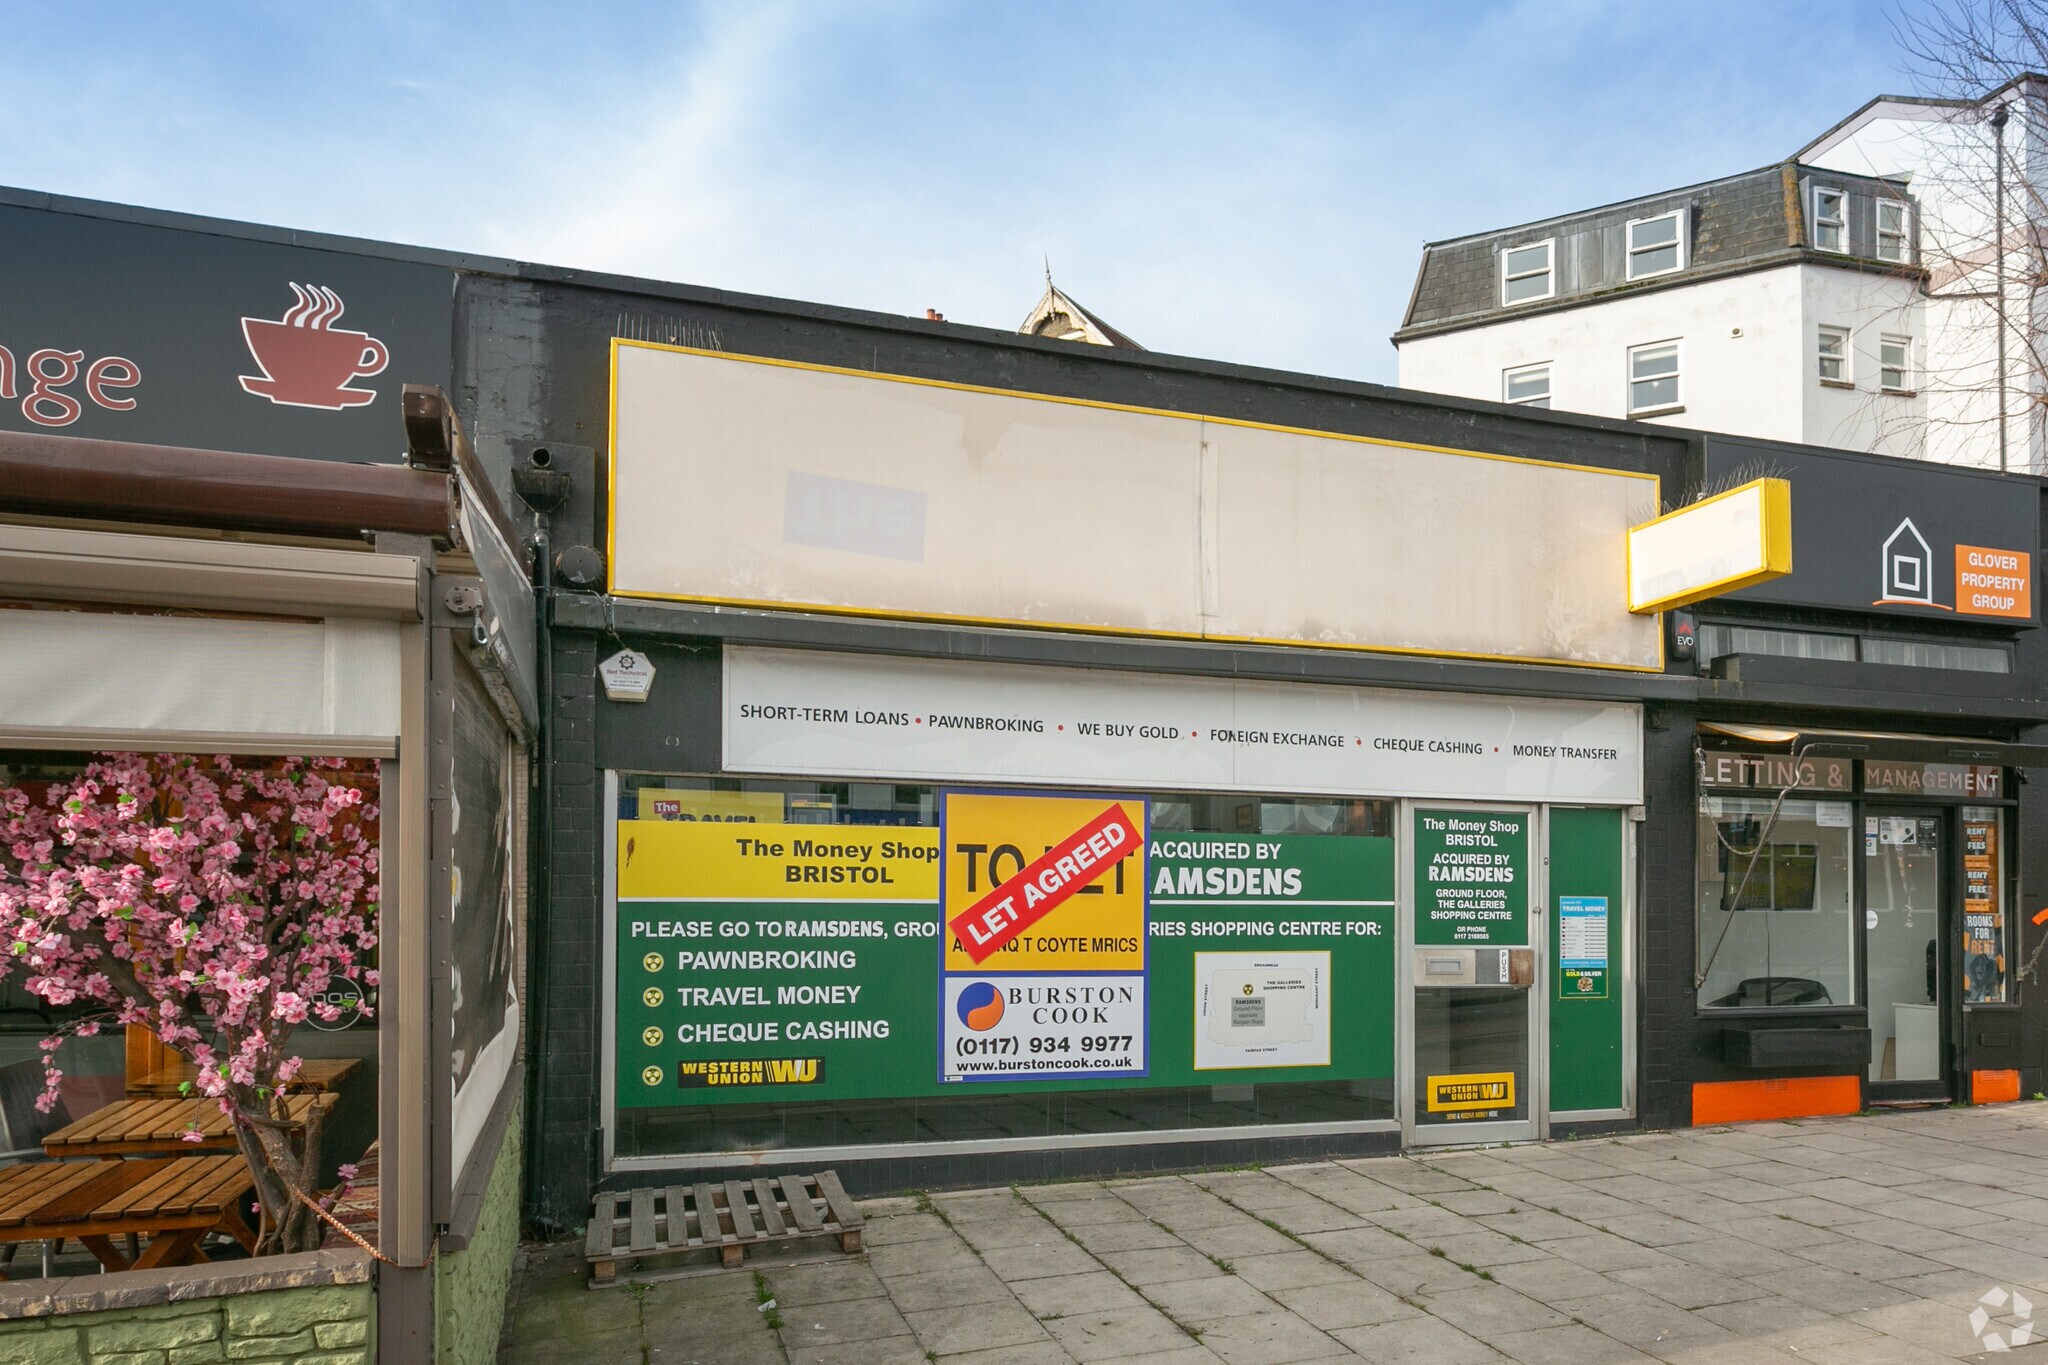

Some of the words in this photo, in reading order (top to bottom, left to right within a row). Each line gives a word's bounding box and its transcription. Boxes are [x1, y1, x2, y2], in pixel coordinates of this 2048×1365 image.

[1968, 552, 2018, 571] GLOVER
[1961, 571, 2025, 592] PROPERTY
[1972, 593, 2015, 611] GROUP
[1677, 635, 1694, 647] EVO
[740, 704, 849, 724] SHORT-TERM
[855, 710, 909, 727] LOANS
[928, 714, 1044, 734] PAWNBROKING
[1077, 722, 1101, 737] WE
[1105, 724, 1135, 738] BUY
[1139, 725, 1179, 740] GOLD
[1210, 729, 1269, 745] FOREIGN
[1272, 732, 1345, 748] EXCHANGE
[1373, 737, 1424, 754] CHEQUE
[1428, 740, 1483, 755] CASHING
[1513, 744, 1556, 758] MONEY
[1560, 746, 1618, 760] TRANSFER
[1699, 758, 1816, 787] LETTING
[1827, 763, 1843, 788] &
[1866, 767, 1999, 791] MANAGEMENT
[655, 802, 678, 813] The
[1423, 818, 1445, 830] The
[1448, 819, 1486, 834] Money
[1489, 820, 1519, 835] Shop
[1446, 834, 1498, 847] BRISTOL
[1967, 841, 1986, 850] FEES
[736, 839, 784, 857] The
[793, 840, 873, 862] Money
[881, 841, 939, 863] Shop
[1150, 841, 1250, 860] ACQUIRED
[1256, 843, 1281, 860] BY
[1433, 853, 1491, 865] ACQUIRED
[1494, 854, 1510, 865] BY
[785, 865, 894, 883] BRISTOL
[1149, 866, 1302, 896] AMSDENS
[1428, 866, 1514, 882] RAMSDENS
[1967, 871, 1988, 879] RENT
[967, 895, 1019, 945] LET
[1023, 822, 1126, 909] AGREED
[1968, 885, 1986, 893] FEES
[1435, 888, 1474, 898] GROUND
[1475, 889, 1507, 899] FLOOR,
[1438, 900, 1455, 908] THE
[1457, 900, 1505, 909] GALLERIES
[1430, 911, 1475, 920] SHOPPING
[1478, 911, 1512, 920] CENTRE
[1967, 915, 1993, 928] ROOMS
[631, 921, 713, 938] PLEASE
[719, 921, 750, 937] GO
[755, 921, 782, 937] TO
[785, 920, 888, 939] RAMSDENS,
[1190, 921, 1275, 936] SHOPPING
[1279, 921, 1342, 936] CENTRE
[1345, 921, 1382, 936] FOR:
[1975, 927, 1990, 939] FOR
[1024, 938, 1032, 952] T
[1037, 937, 1088, 952] COYTE
[1092, 937, 1138, 953] MRICS
[1971, 939, 1996, 955] RENT
[678, 950, 857, 970] PAWNBROKING
[677, 986, 771, 1007] TRAVEL
[777, 985, 861, 1005] MONEY
[1008, 986, 1133, 1005] BURSTON
[1032, 1007, 1109, 1025] COOK
[677, 1022, 779, 1044] CHEQUE
[785, 1020, 890, 1040] CASHING
[956, 1035, 1019, 1057] (0117)
[1029, 1036, 1071, 1053] 934
[1080, 1035, 1133, 1053] 9977
[682, 1061, 763, 1075] WESTERN
[771, 1059, 818, 1083] WU
[956, 1056, 1132, 1072] www.burstoncook.co.uk
[708, 1072, 763, 1084] UNION
[1439, 1085, 1478, 1094] WESTERN
[1451, 1092, 1478, 1101] UNION
